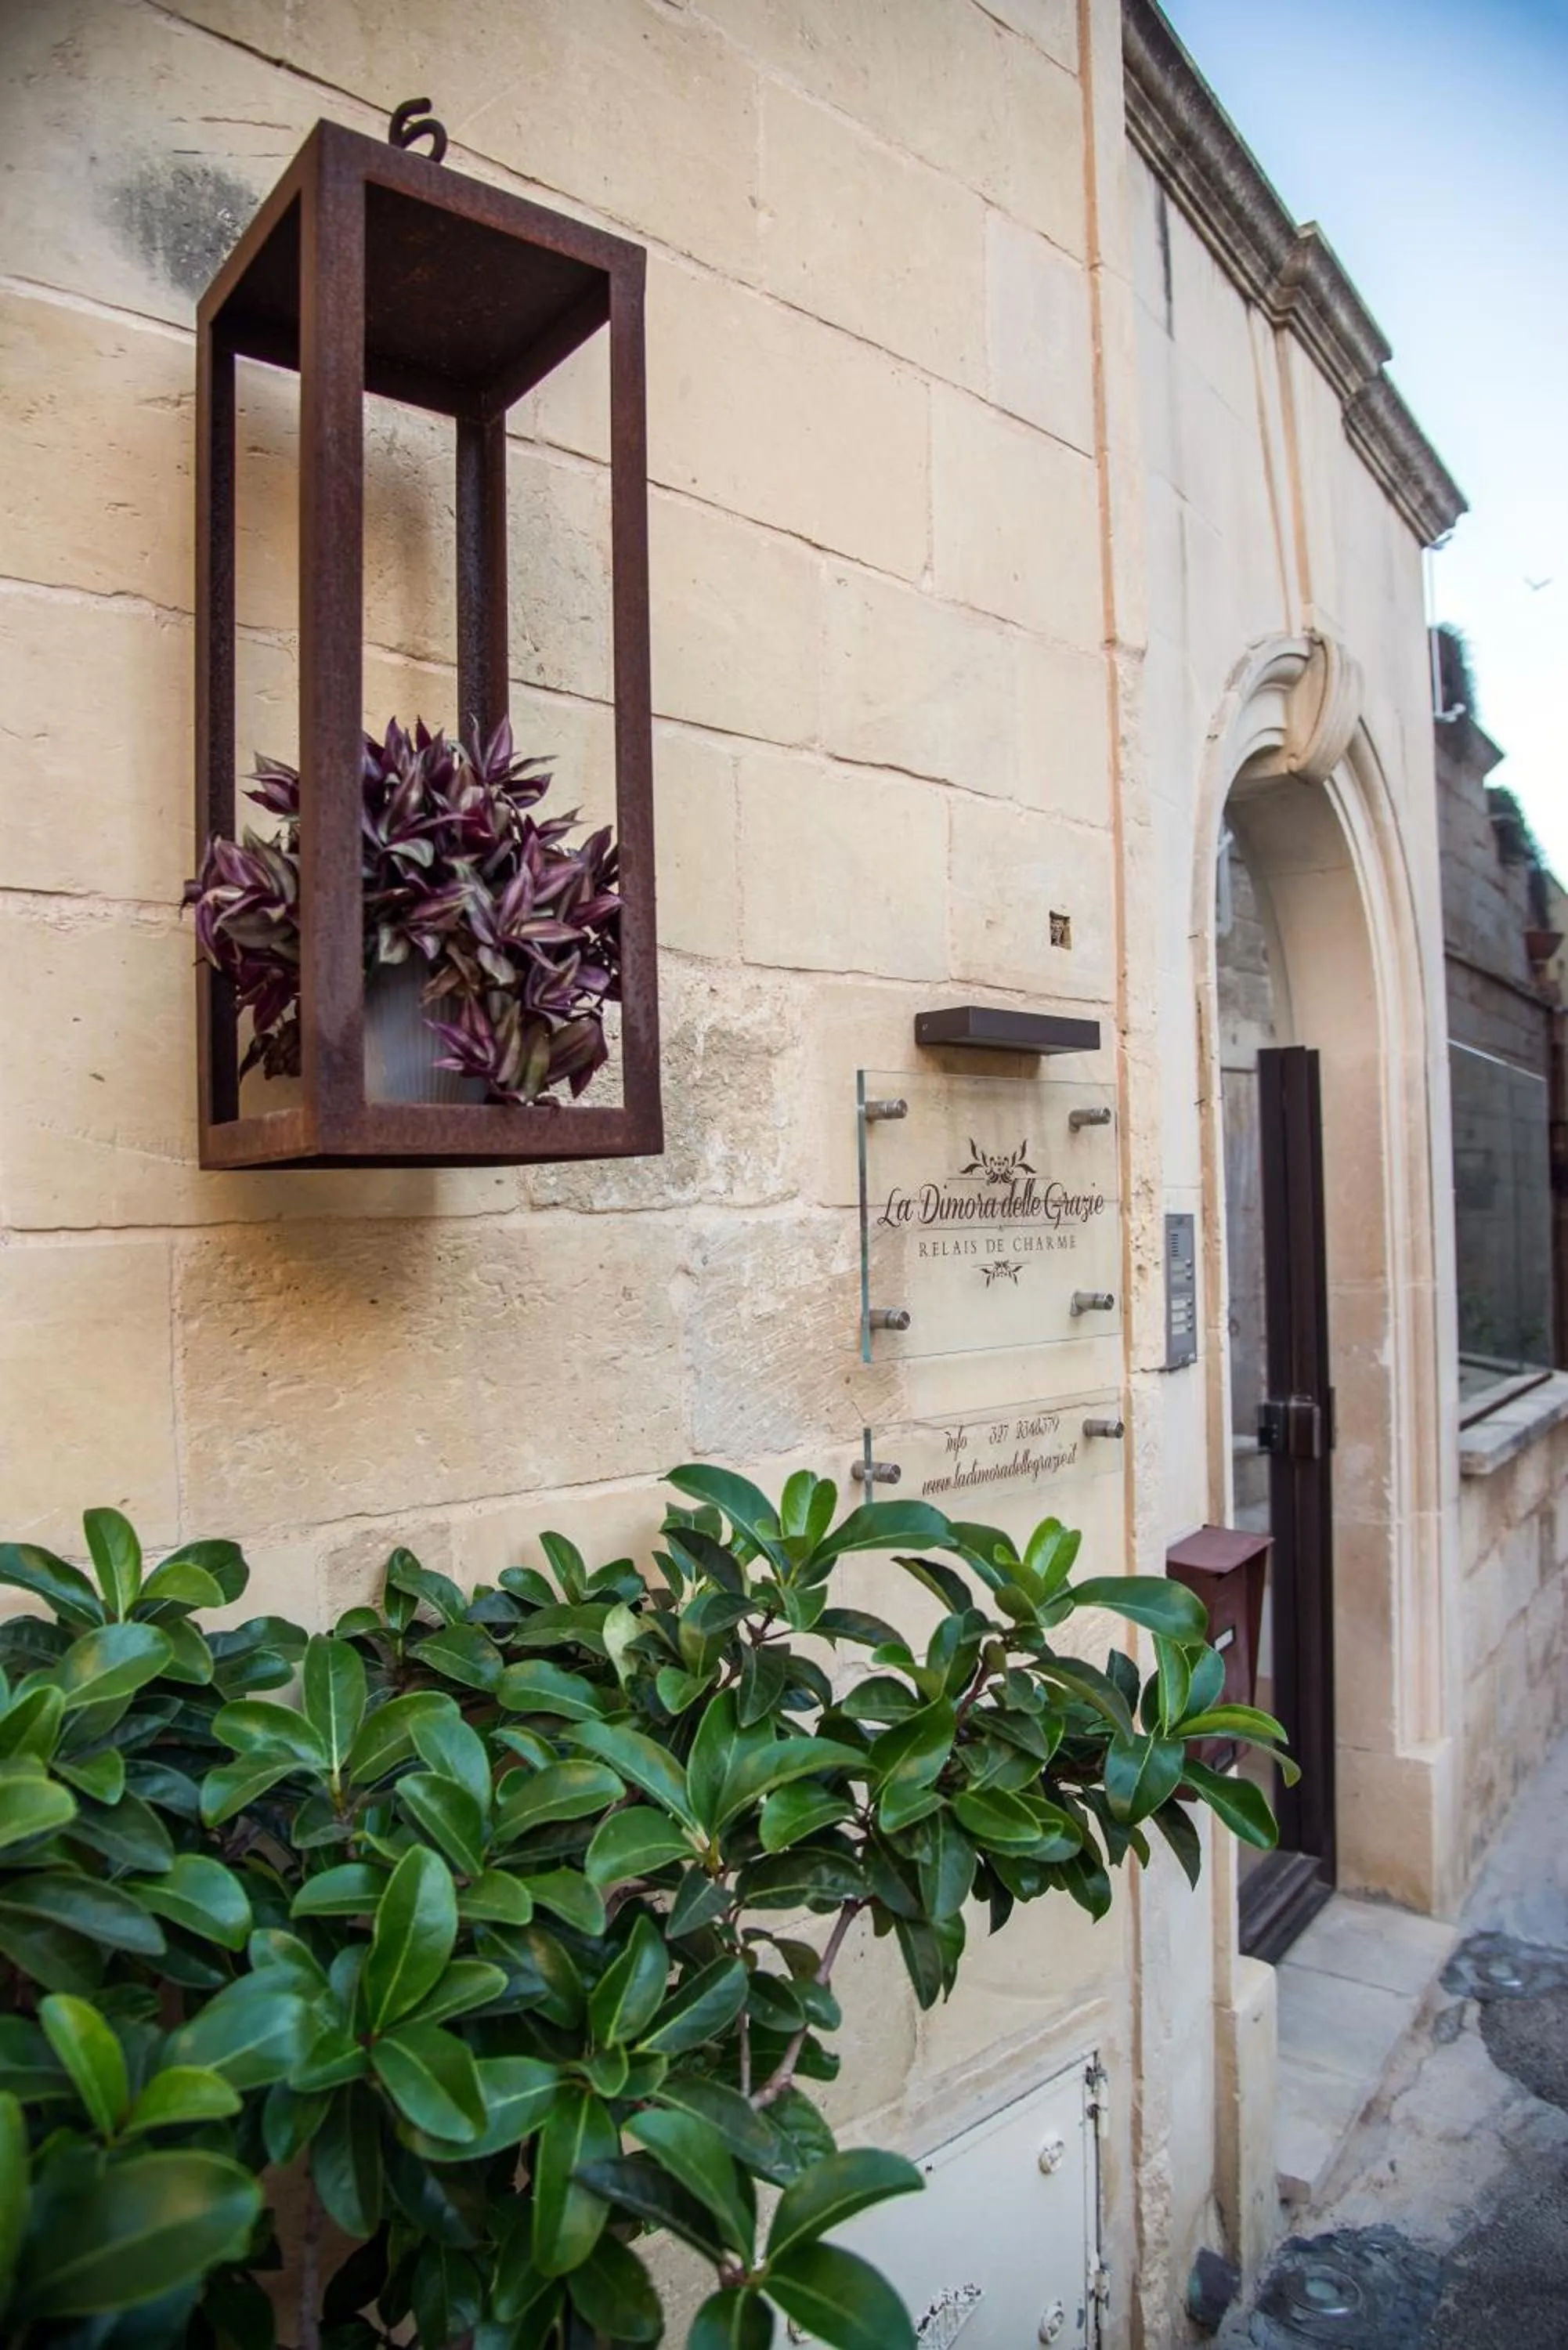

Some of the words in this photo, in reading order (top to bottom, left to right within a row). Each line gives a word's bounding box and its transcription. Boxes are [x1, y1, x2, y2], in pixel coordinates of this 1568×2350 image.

[876, 1186, 914, 1228] La
[918, 1183, 998, 1224] Dimora
[1001, 1177, 1042, 1218] delle
[1044, 1181, 1104, 1231] Grazie
[919, 1240, 977, 1257] RELAIS
[986, 1238, 1004, 1254] DE
[1013, 1234, 1077, 1253] CHARME
